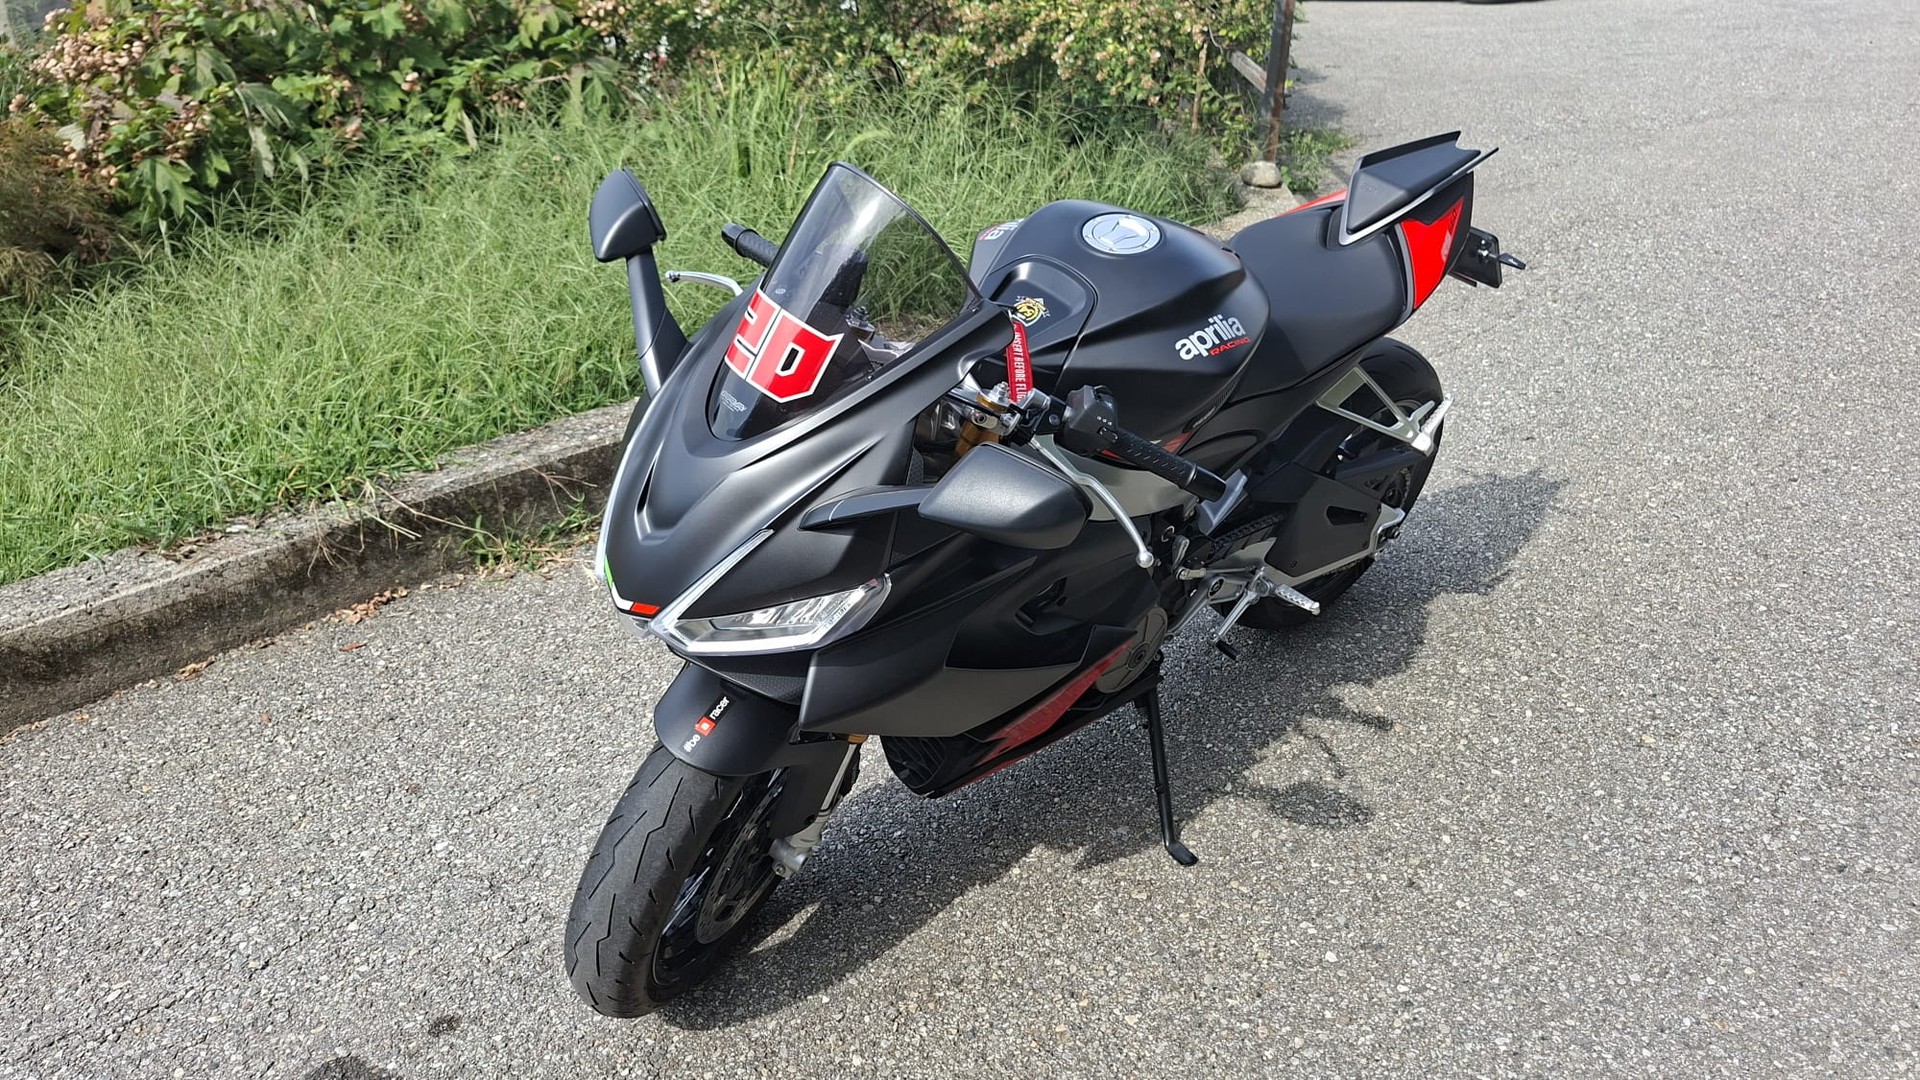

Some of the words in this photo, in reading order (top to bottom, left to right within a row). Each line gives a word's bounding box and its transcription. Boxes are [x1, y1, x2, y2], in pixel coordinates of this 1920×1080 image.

[1013, 331, 1024, 356] INSERT
[1175, 314, 1246, 360] aprilia
[1209, 336, 1251, 356] RACING
[1013, 357, 1026, 382] BEFORE
[1015, 383, 1027, 402] FLIG
[683, 734, 700, 752] #be
[709, 696, 729, 720] racer
